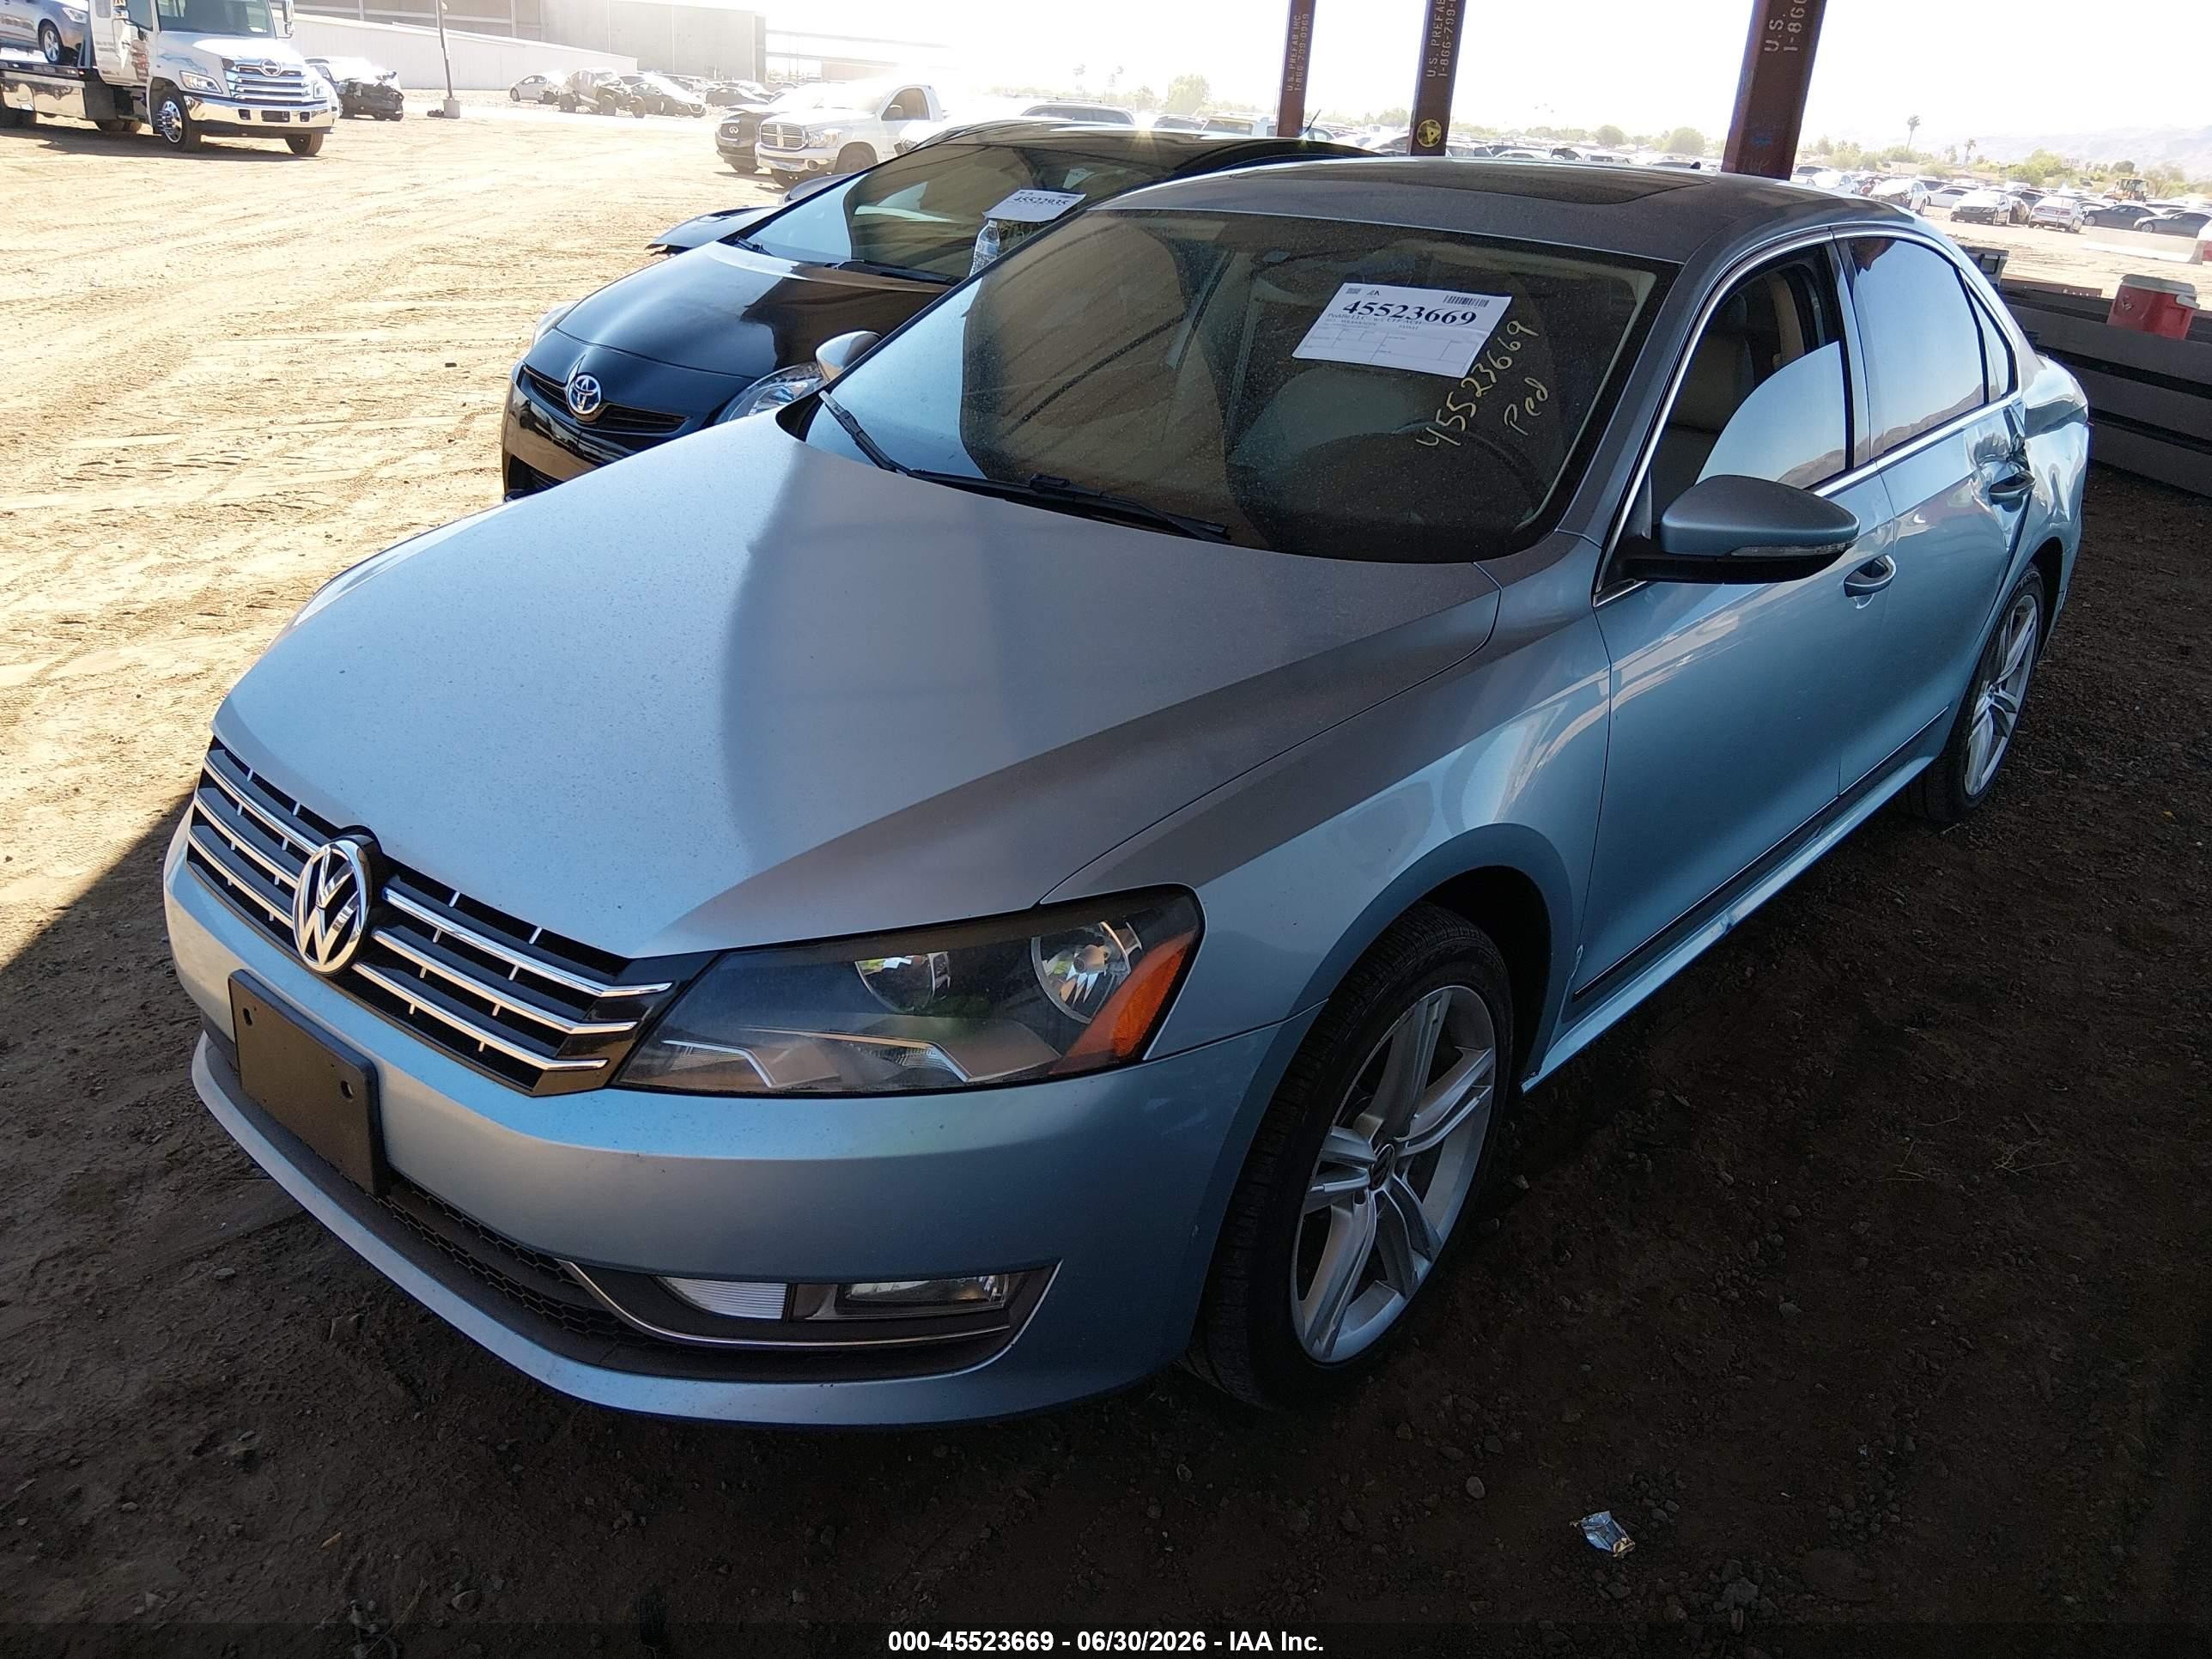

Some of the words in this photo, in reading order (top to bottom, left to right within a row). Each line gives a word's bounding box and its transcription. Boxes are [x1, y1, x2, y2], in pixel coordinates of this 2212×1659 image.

[1764, 14, 1786, 52] U.S.
[1342, 301, 1477, 326] 45523669
[1415, 320, 1540, 447] 45523669
